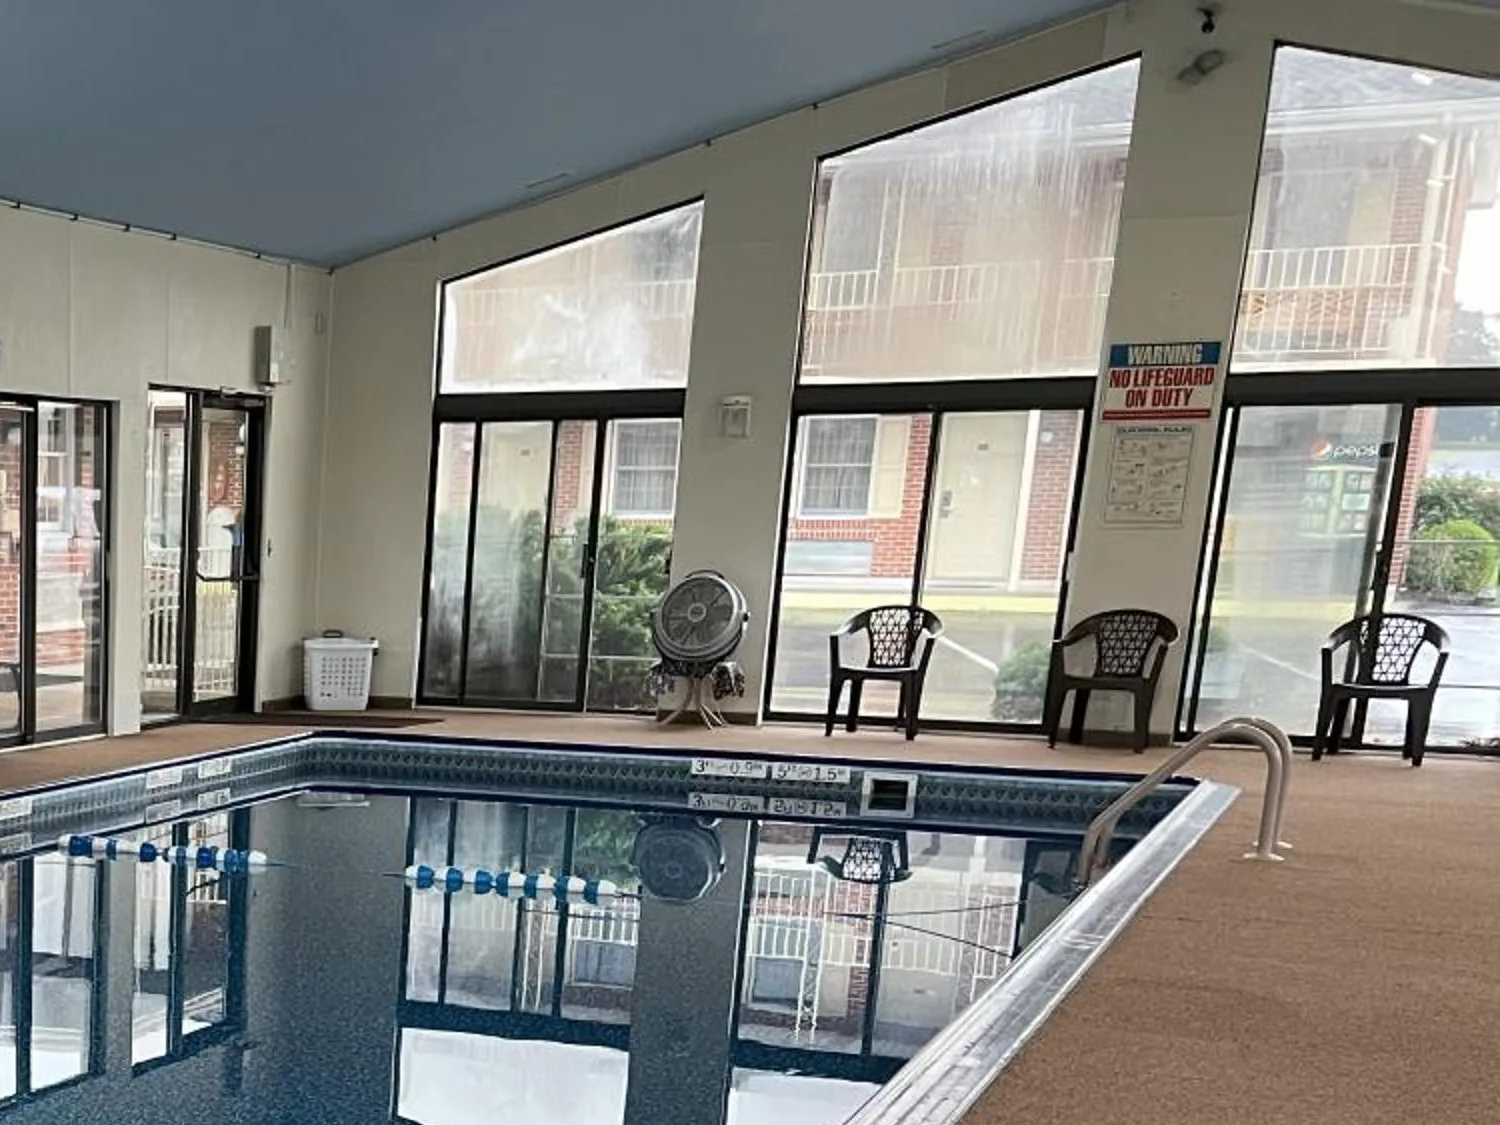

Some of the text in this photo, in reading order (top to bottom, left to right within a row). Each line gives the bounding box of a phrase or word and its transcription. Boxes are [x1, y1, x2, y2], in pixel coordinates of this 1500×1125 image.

[1127, 343, 1204, 366] WARNING
[1109, 367, 1215, 388] NO LIFEGUARD
[1125, 387, 1195, 408] ON DUTY
[1333, 443, 1379, 458] pepsi
